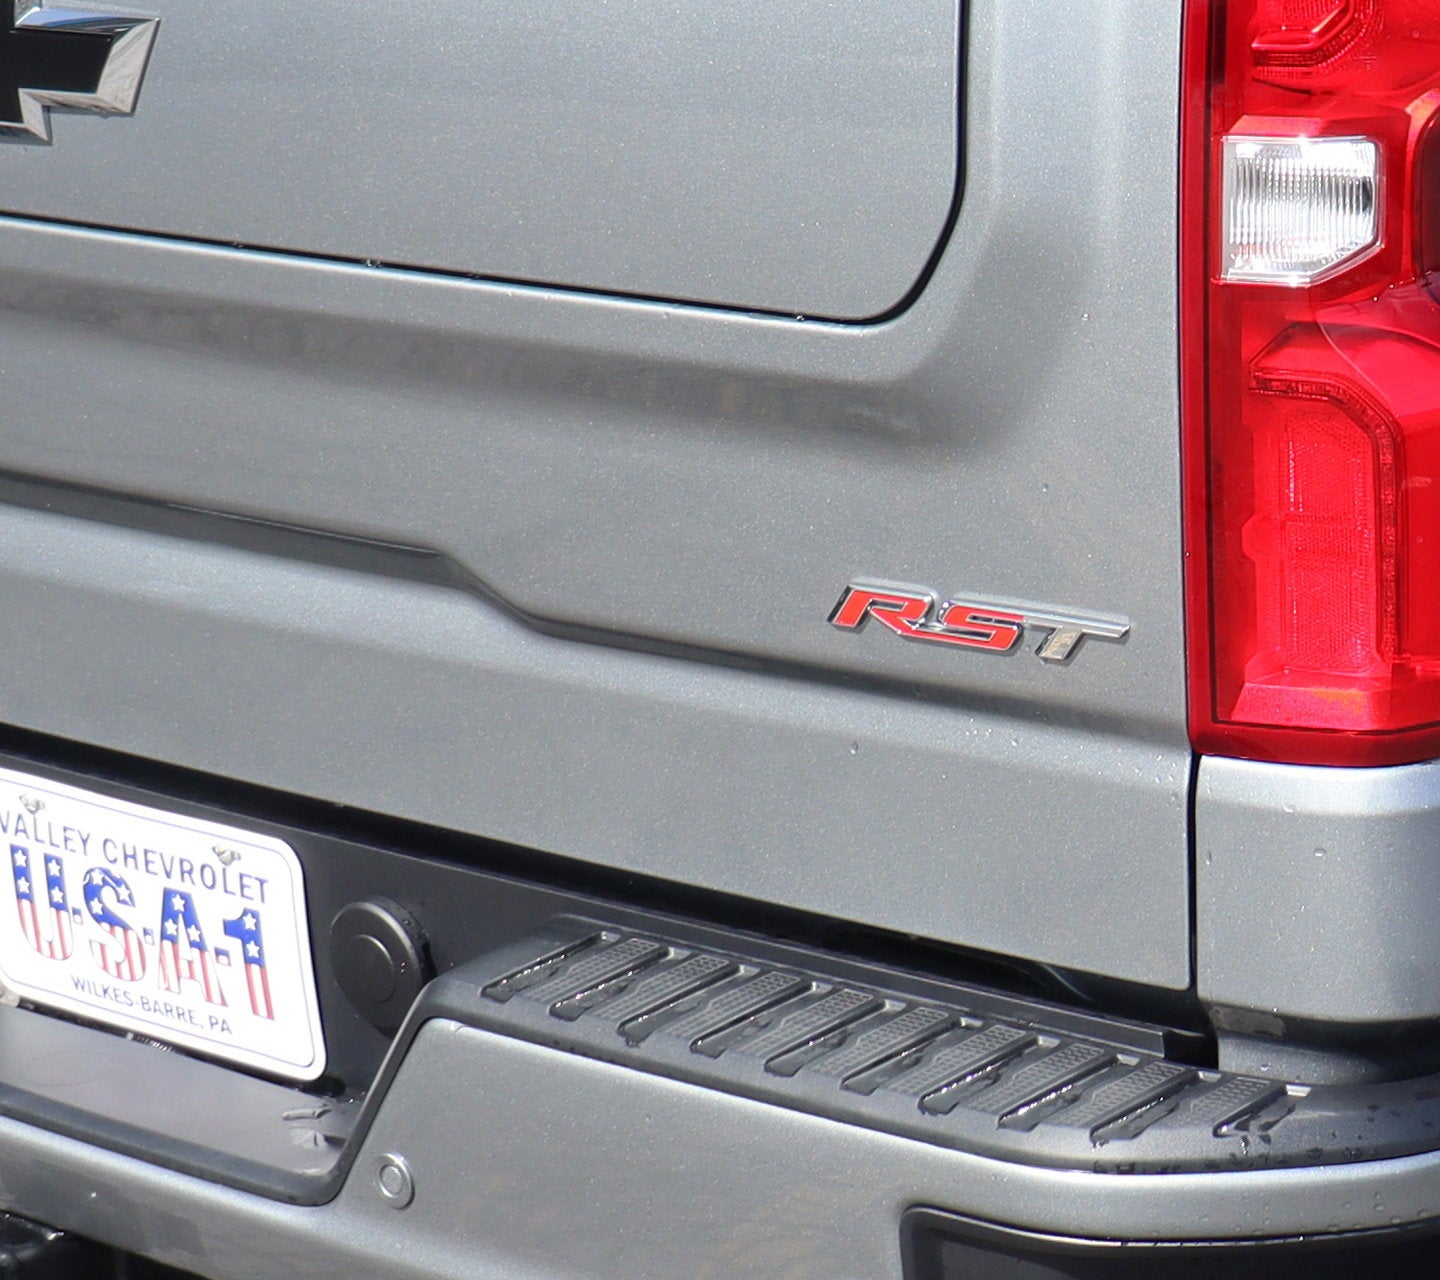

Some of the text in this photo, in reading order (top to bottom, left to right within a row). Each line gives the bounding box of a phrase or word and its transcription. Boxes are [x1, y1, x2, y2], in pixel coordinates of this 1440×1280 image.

[827, 582, 1131, 661] RST
[102, 838, 269, 904] CHEVROLET
[70, 975, 233, 1035] WILKES-BARRE, PA
